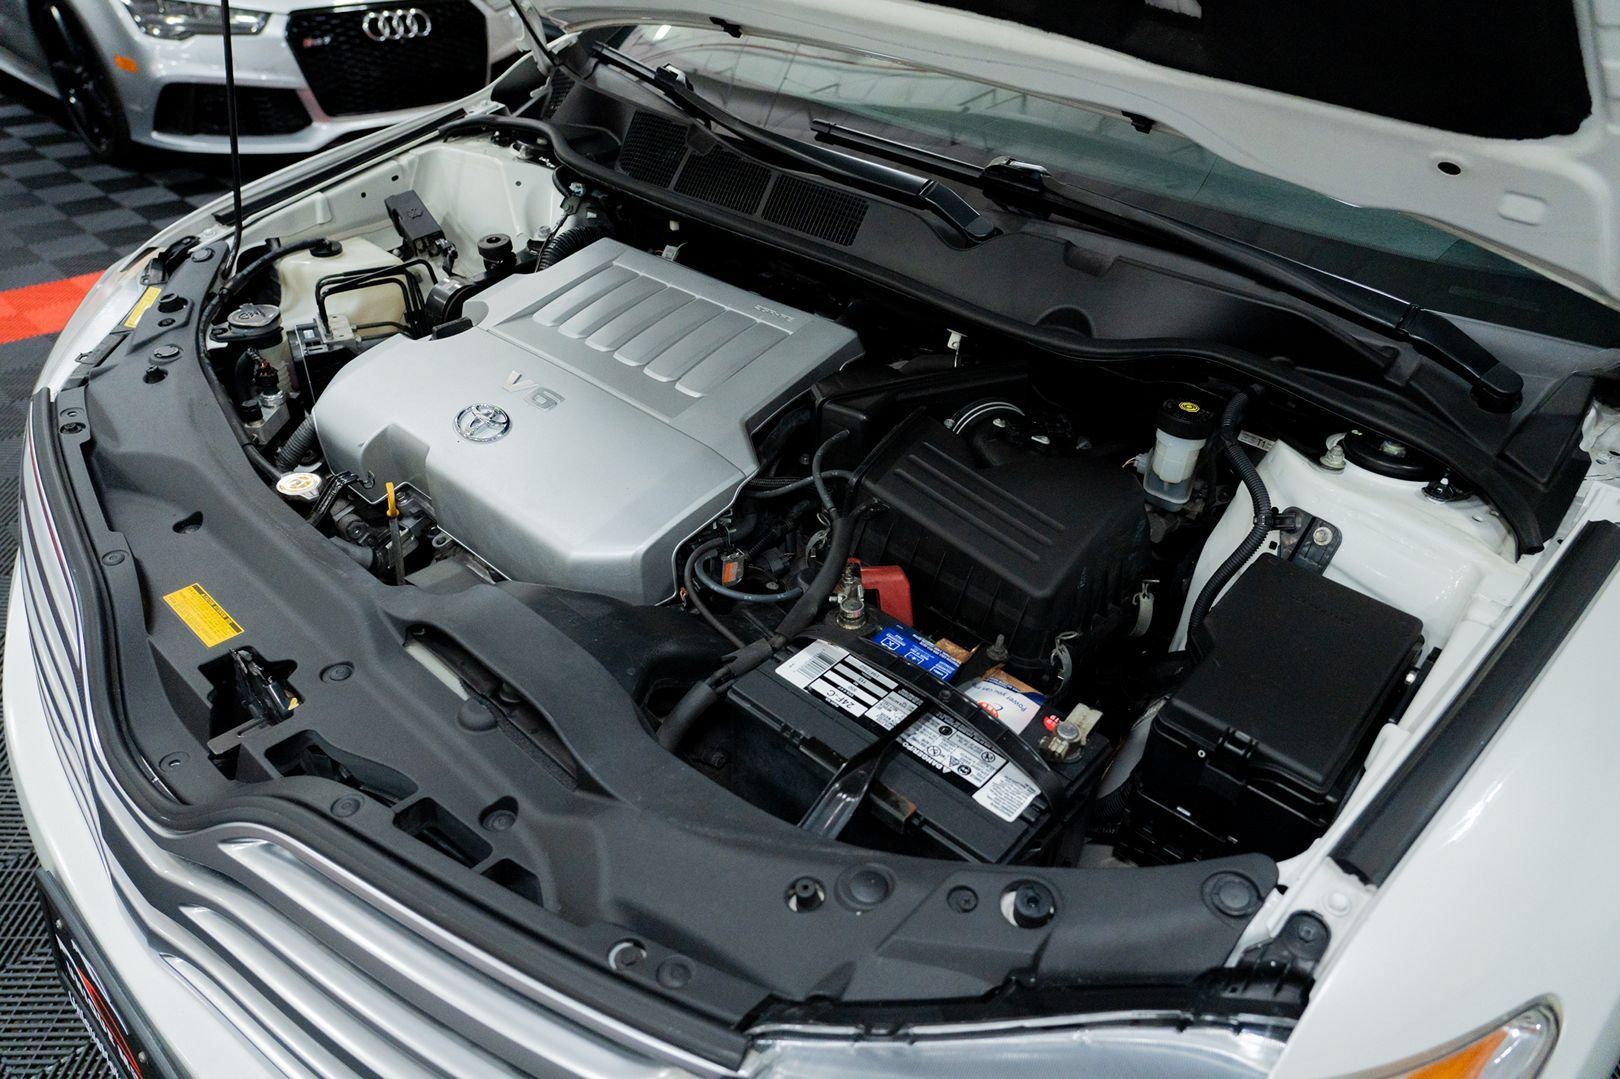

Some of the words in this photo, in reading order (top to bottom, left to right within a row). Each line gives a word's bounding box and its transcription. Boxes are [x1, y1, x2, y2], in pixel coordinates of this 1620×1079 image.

[502, 370, 567, 411] V6
[826, 689, 856, 709] 24F-C
[1005, 695, 1028, 712] Power
[897, 738, 943, 770] DANGER/PO
